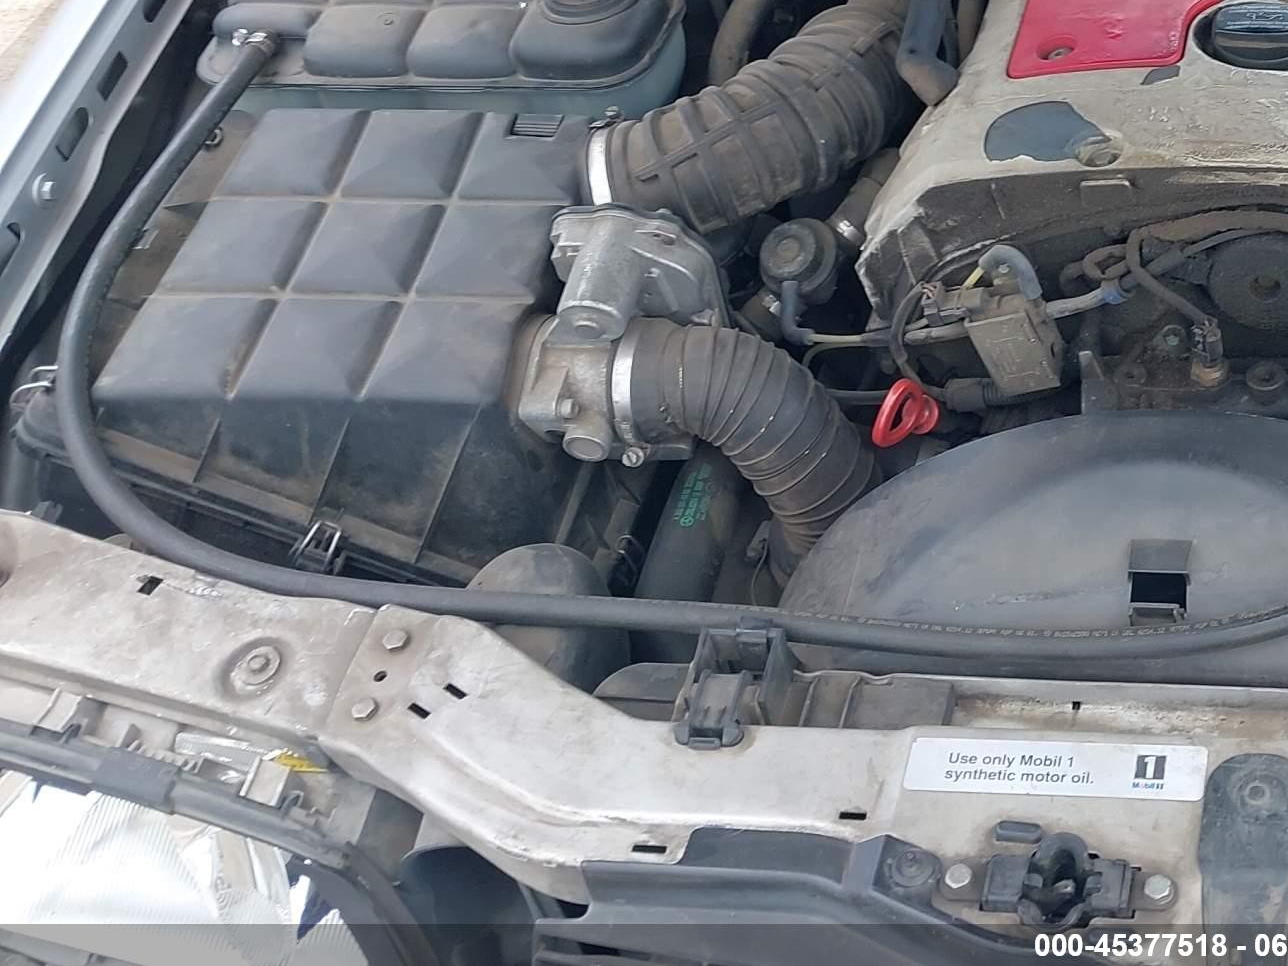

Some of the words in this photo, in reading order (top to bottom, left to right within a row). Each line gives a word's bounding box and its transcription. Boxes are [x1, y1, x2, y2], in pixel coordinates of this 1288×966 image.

[948, 752, 977, 765] Use
[982, 754, 1014, 770] only
[1019, 754, 1062, 767] Mobil
[1067, 756, 1074, 768] 1
[944, 768, 1016, 784] synthetic
[1020, 772, 1066, 784] motor
[1071, 772, 1094, 785] oil.
